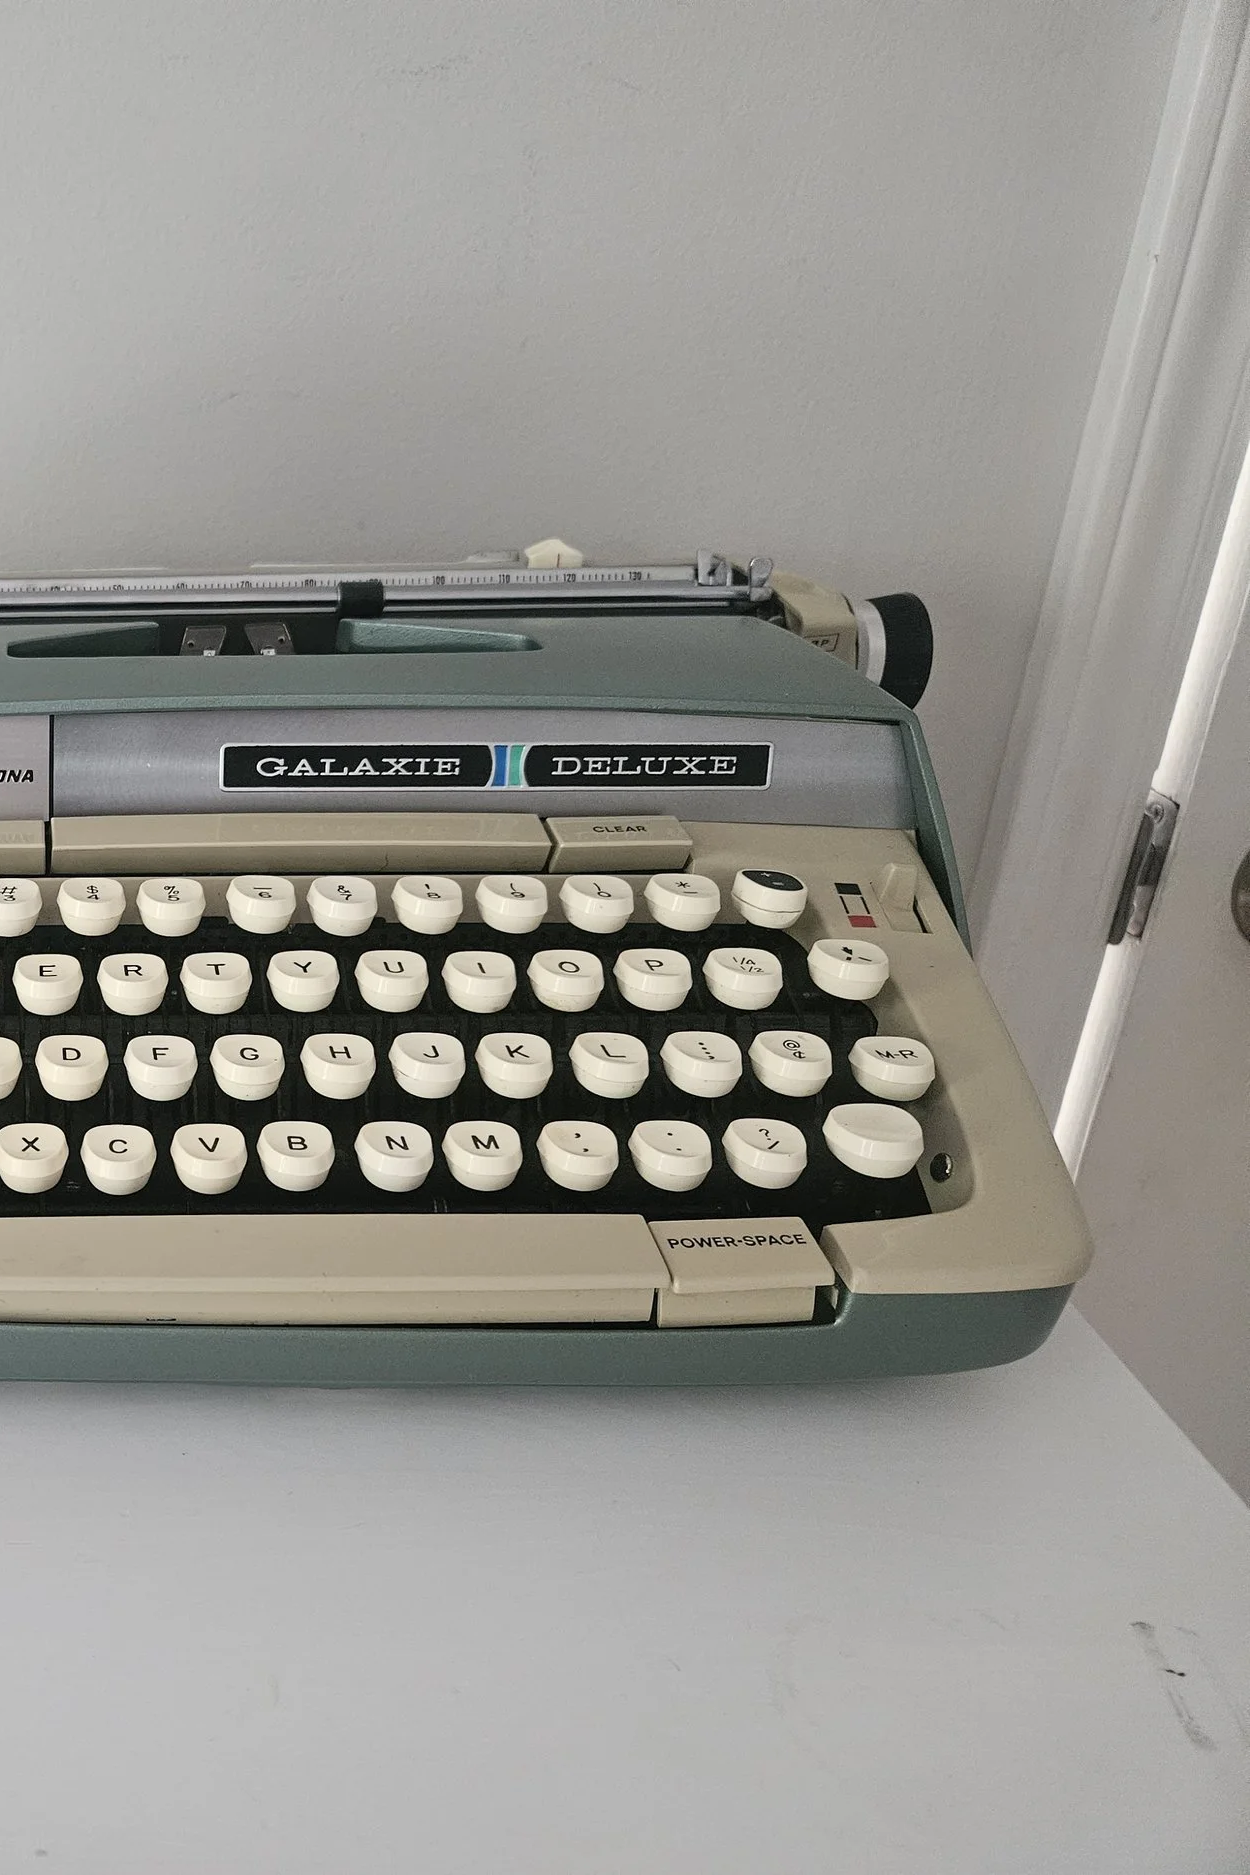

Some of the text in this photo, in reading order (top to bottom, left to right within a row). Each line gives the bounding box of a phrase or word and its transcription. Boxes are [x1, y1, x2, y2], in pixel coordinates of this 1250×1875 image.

[432, 575, 446, 585] 100
[498, 574, 510, 584] 110
[563, 573, 576, 583] 120
[629, 571, 641, 581] 130
[256, 756, 737, 777] GALAXIE DELUXE
[592, 825, 647, 833] CLEAR
[0, 885, 18, 895] #
[86, 884, 99, 894] $
[163, 885, 180, 895] %
[258, 891, 272, 899] 6
[337, 884, 351, 894] &
[2, 894, 17, 902] 3
[167, 894, 181, 902] 5
[340, 893, 353, 901] 7
[39, 964, 58, 978] E
[123, 964, 143, 977] R
[206, 963, 226, 976] T
[293, 961, 312, 974] Y
[383, 961, 405, 974] U
[477, 962, 486, 974] I
[557, 961, 581, 974] O
[644, 959, 664, 972] P
[505, 1044, 530, 1059] K
[600, 1044, 627, 1058] L
[782, 1039, 801, 1051] @
[61, 1047, 82, 1061] D
[152, 1047, 169, 1061] F
[239, 1047, 260, 1061] G
[328, 1045, 352, 1059] H
[423, 1045, 440, 1059] J
[874, 1049, 918, 1059] M-R
[758, 1128, 773, 1142] ?
[21, 1136, 41, 1153] X
[108, 1139, 128, 1154] C
[197, 1137, 220, 1153] V
[286, 1135, 308, 1151] B
[385, 1135, 410, 1151] N
[471, 1134, 500, 1150] M
[666, 1233, 807, 1249] POWER-SPACE
